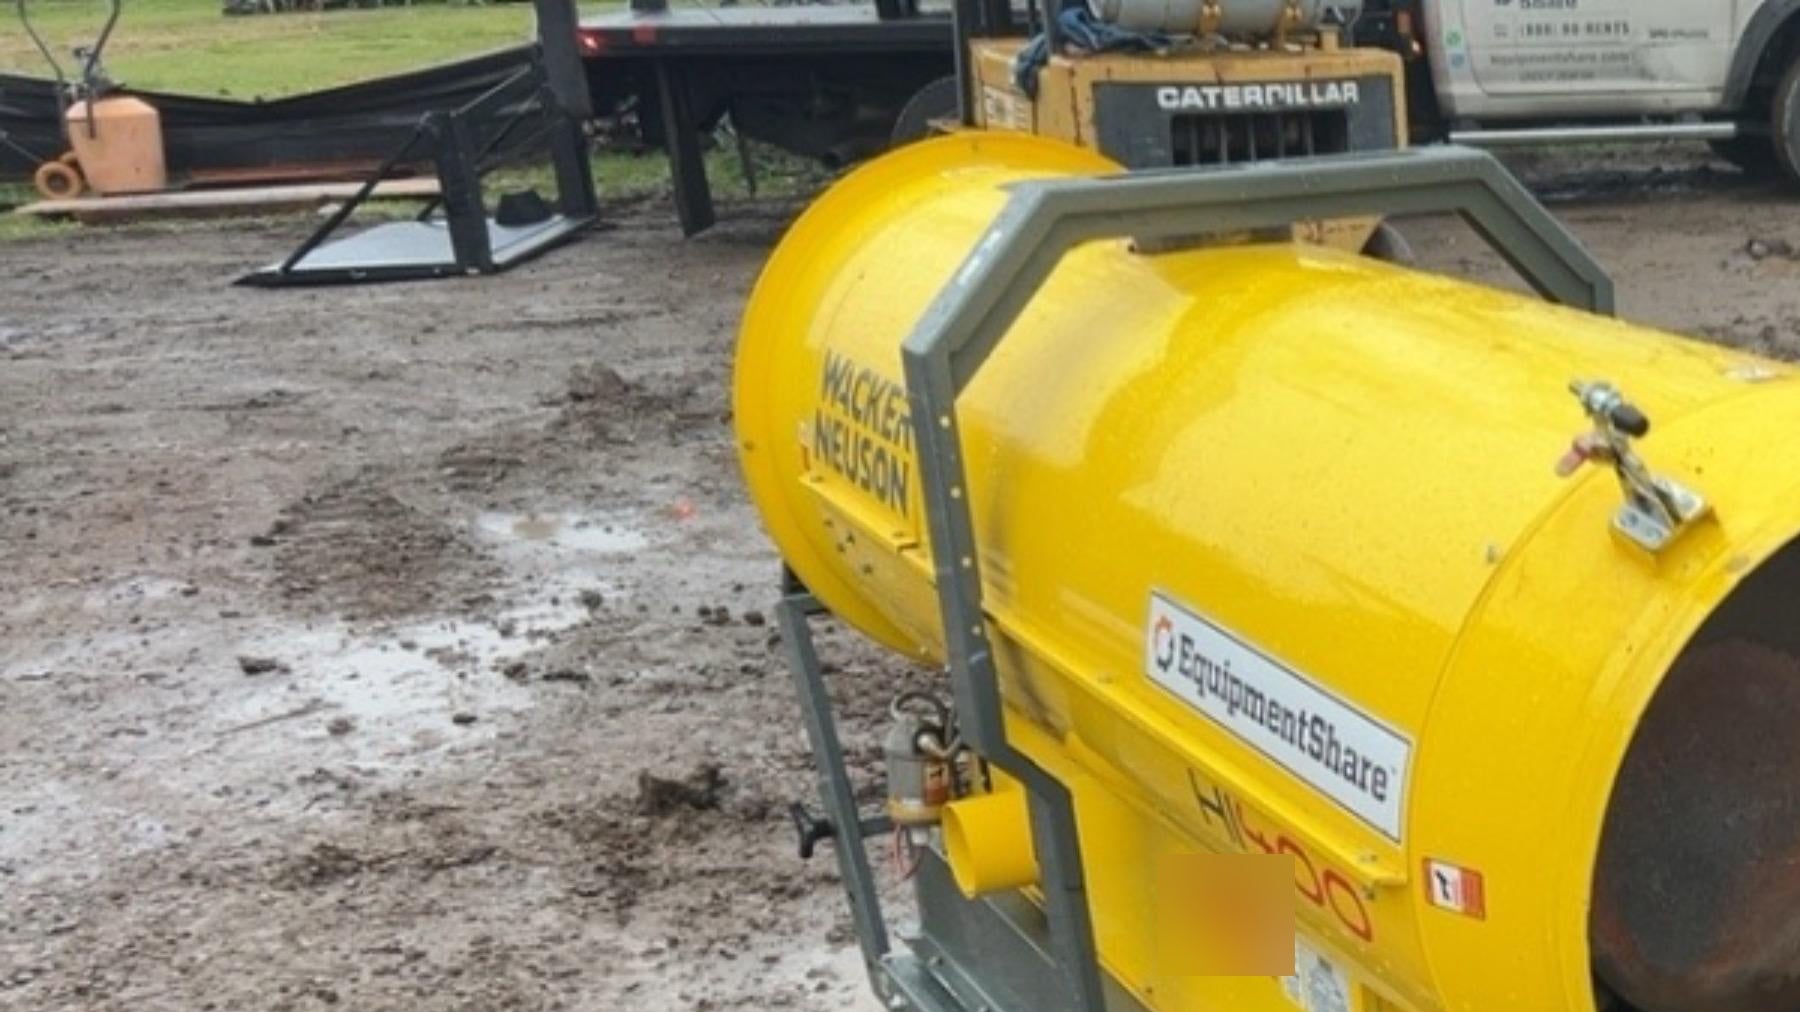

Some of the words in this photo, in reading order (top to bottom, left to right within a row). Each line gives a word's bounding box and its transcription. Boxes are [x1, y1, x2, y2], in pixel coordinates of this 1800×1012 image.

[1156, 80, 1360, 109] CATERPILLAR
[814, 408, 910, 519] NEUSON
[1178, 632, 1388, 803] EquipmentShare
